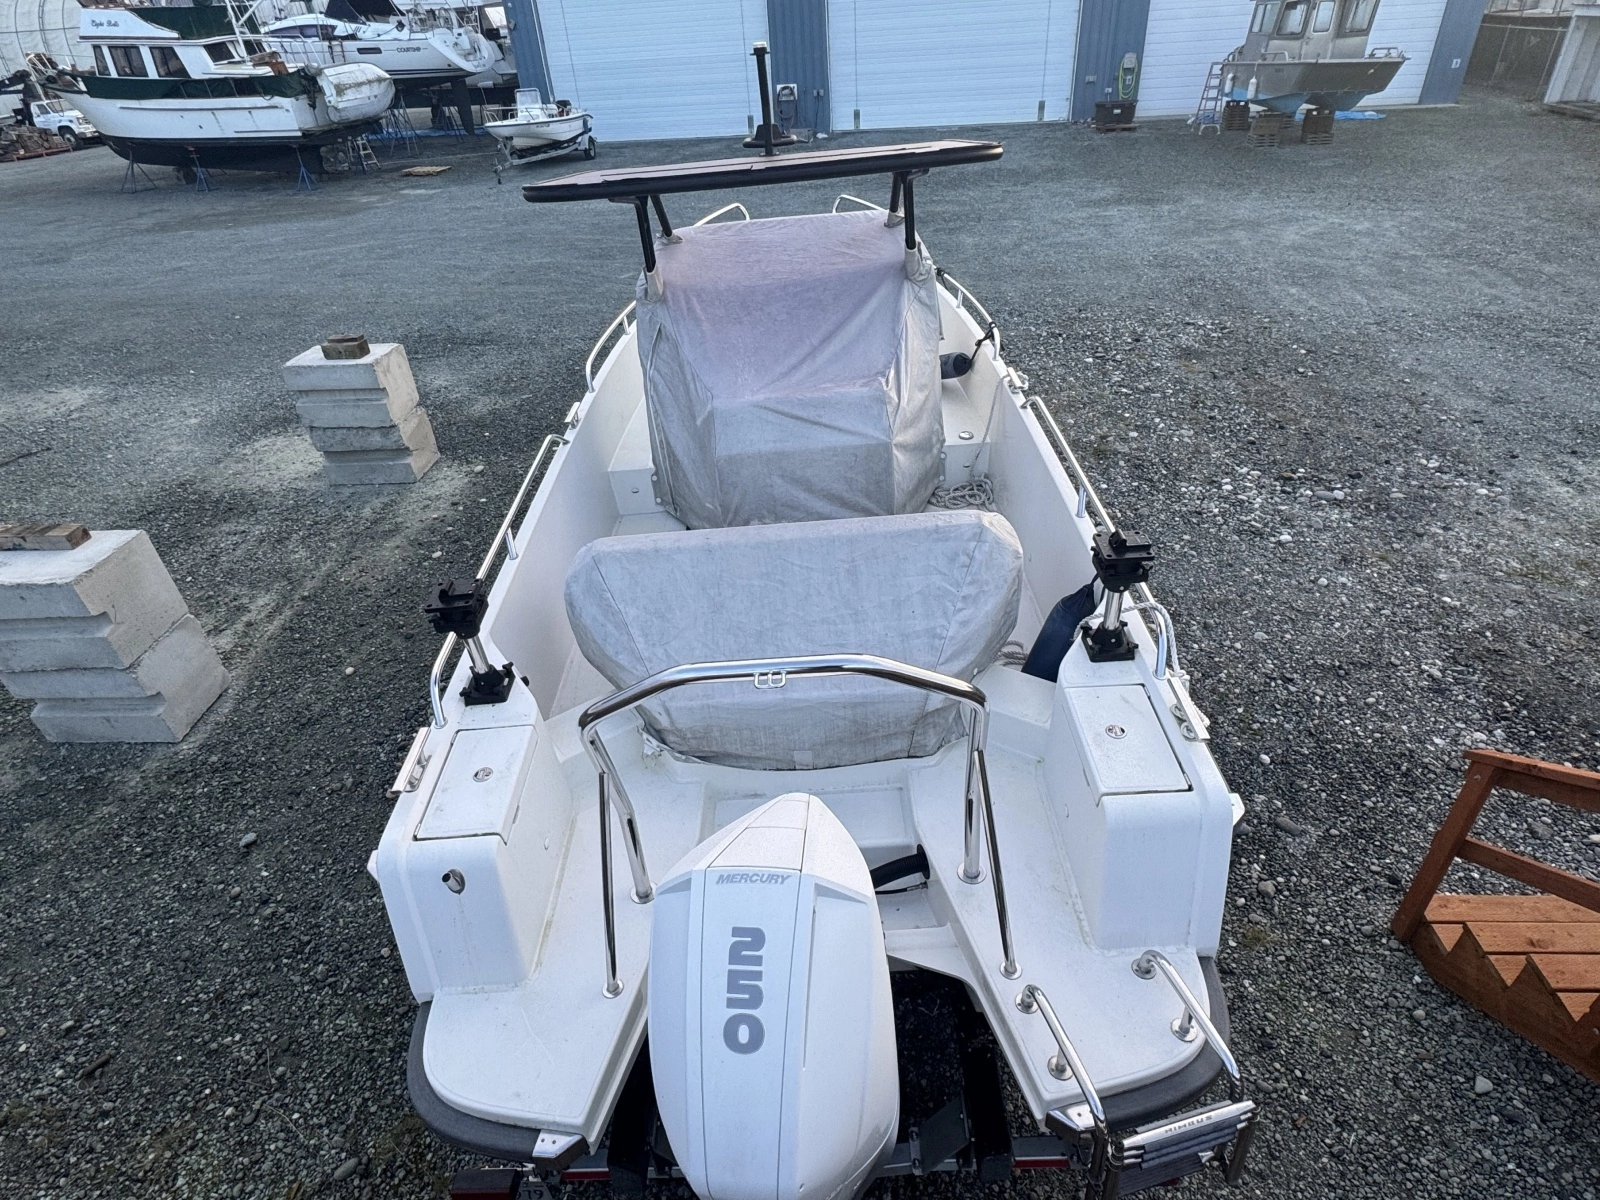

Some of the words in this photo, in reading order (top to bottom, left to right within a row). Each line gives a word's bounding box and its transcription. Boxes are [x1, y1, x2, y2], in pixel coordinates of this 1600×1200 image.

[716, 873, 791, 885] MERCURY
[723, 926, 766, 1055] 250
[1165, 1115, 1213, 1133] NIMBUS
